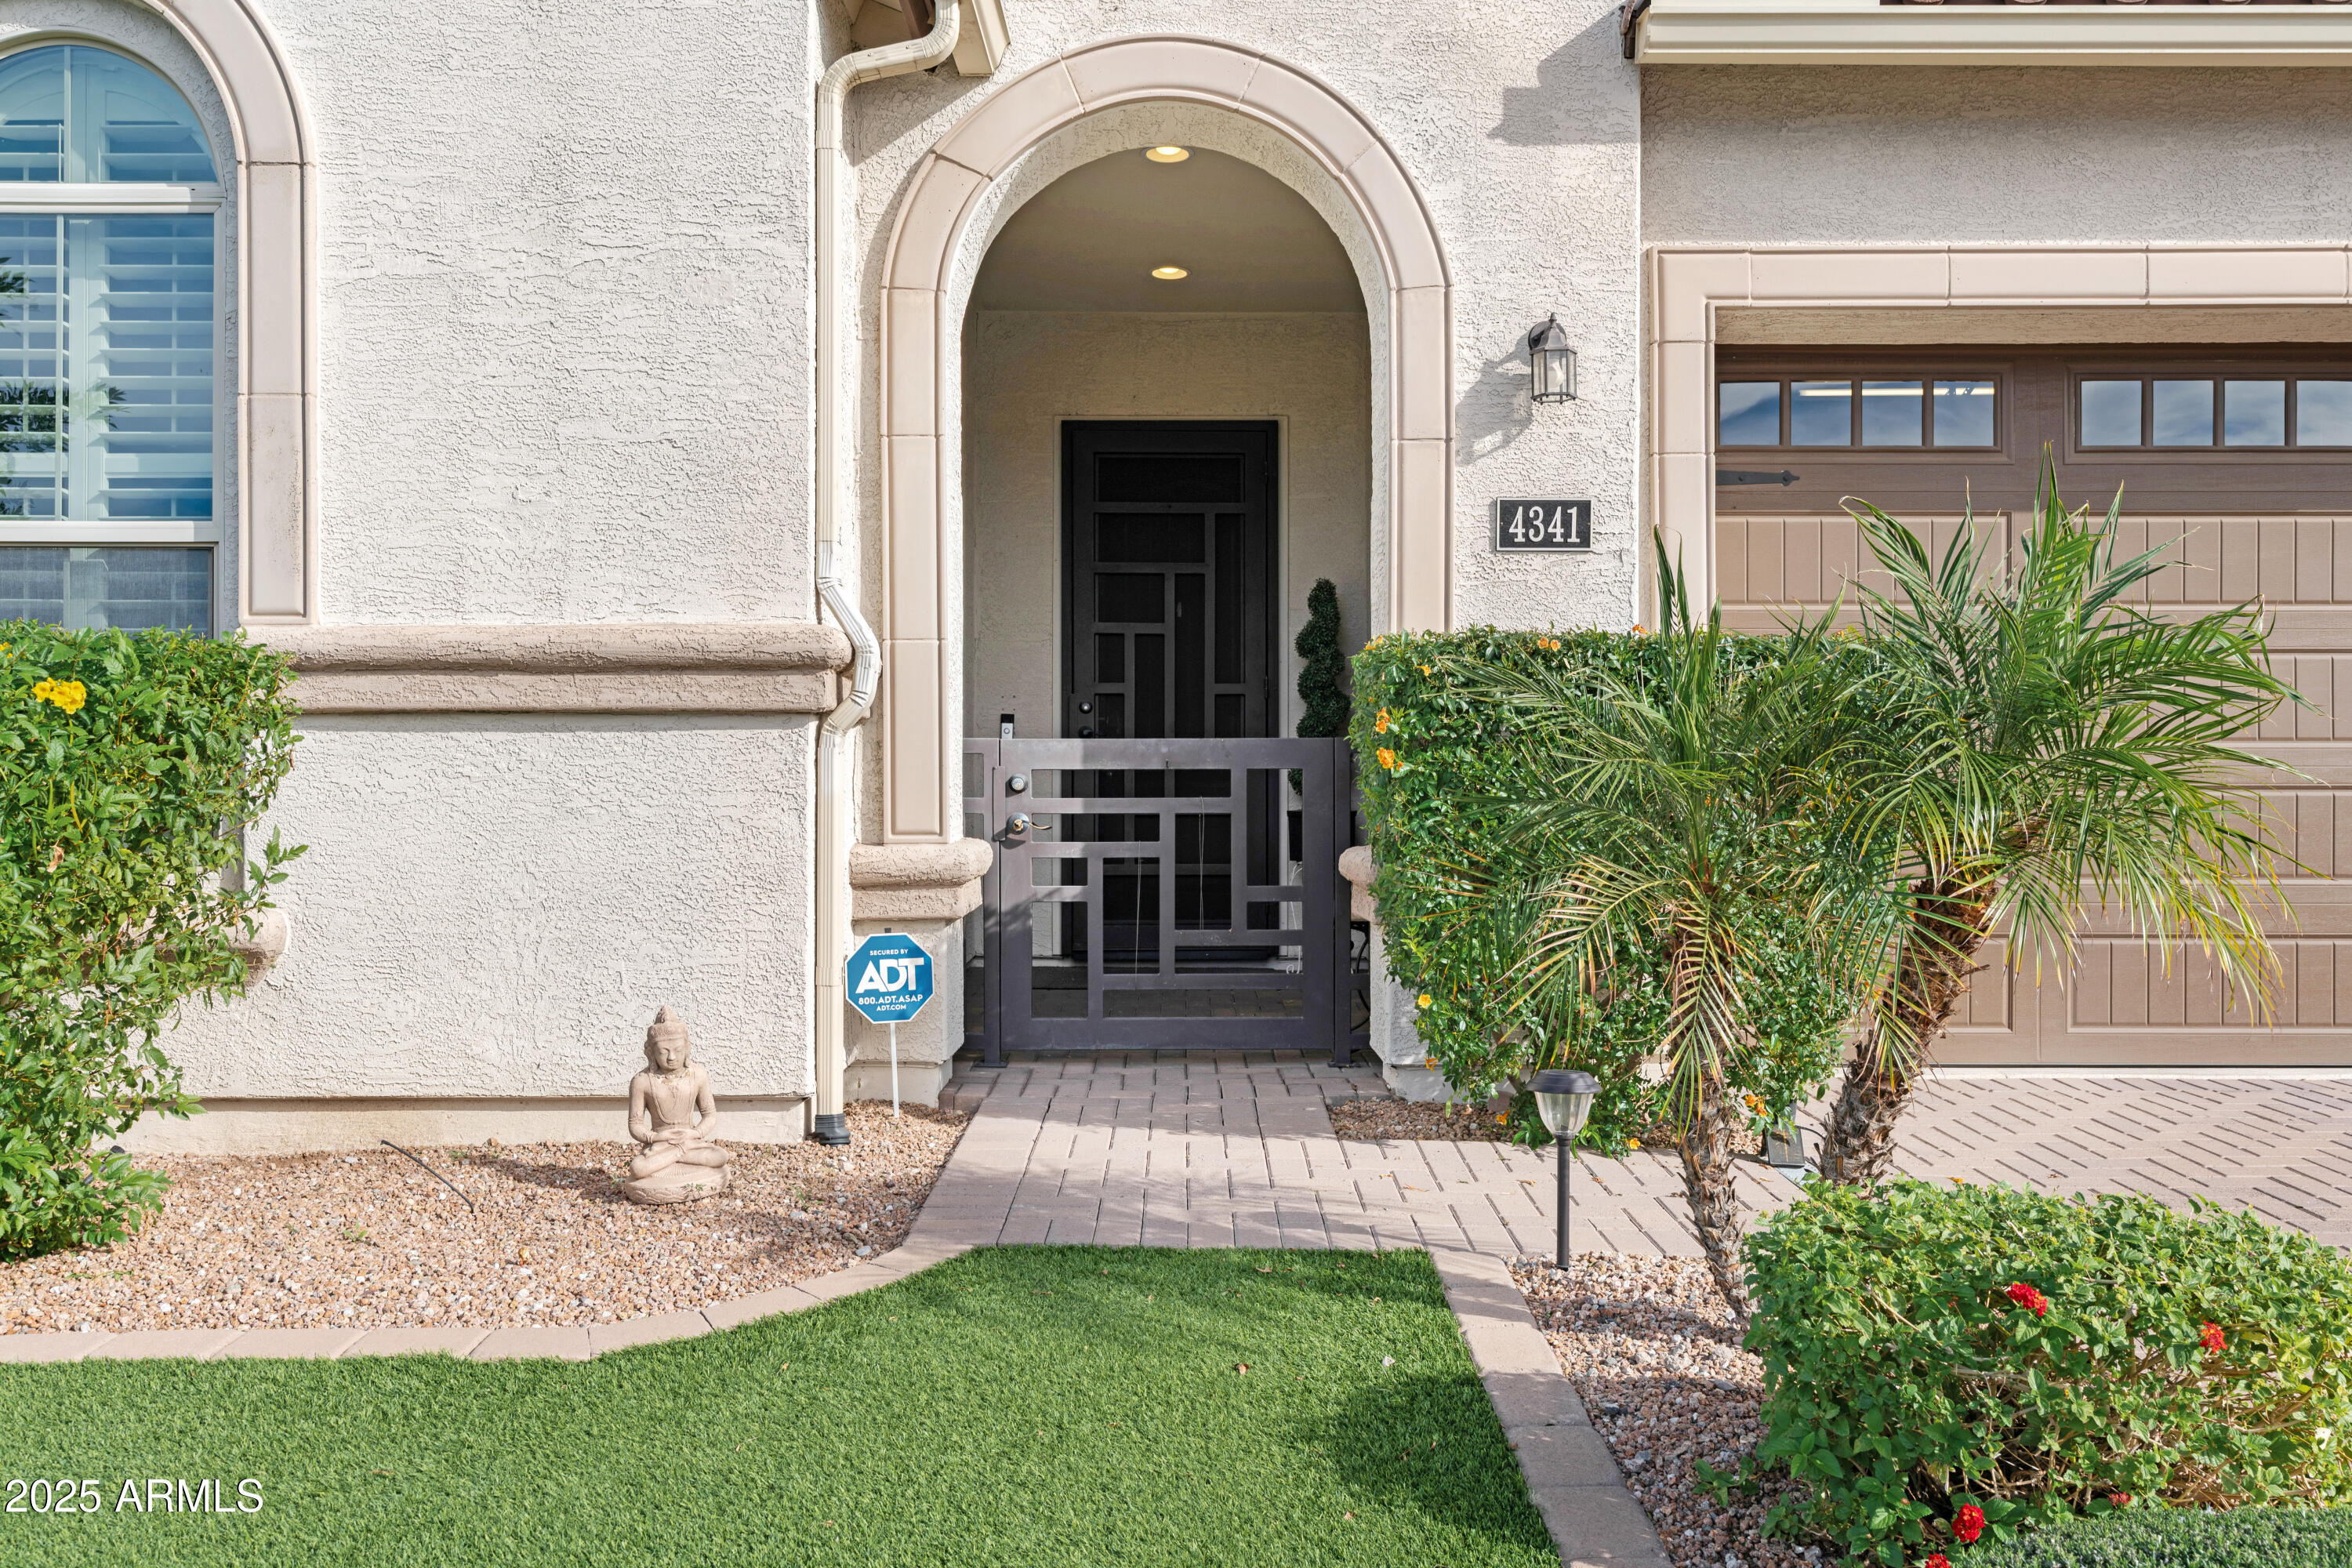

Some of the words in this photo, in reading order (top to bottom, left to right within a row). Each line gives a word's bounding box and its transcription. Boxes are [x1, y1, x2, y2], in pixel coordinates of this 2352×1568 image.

[1508, 506, 1581, 543] 4341
[855, 957, 924, 994] ADT
[858, 994, 924, 1005] 800.ADT.ASAP
